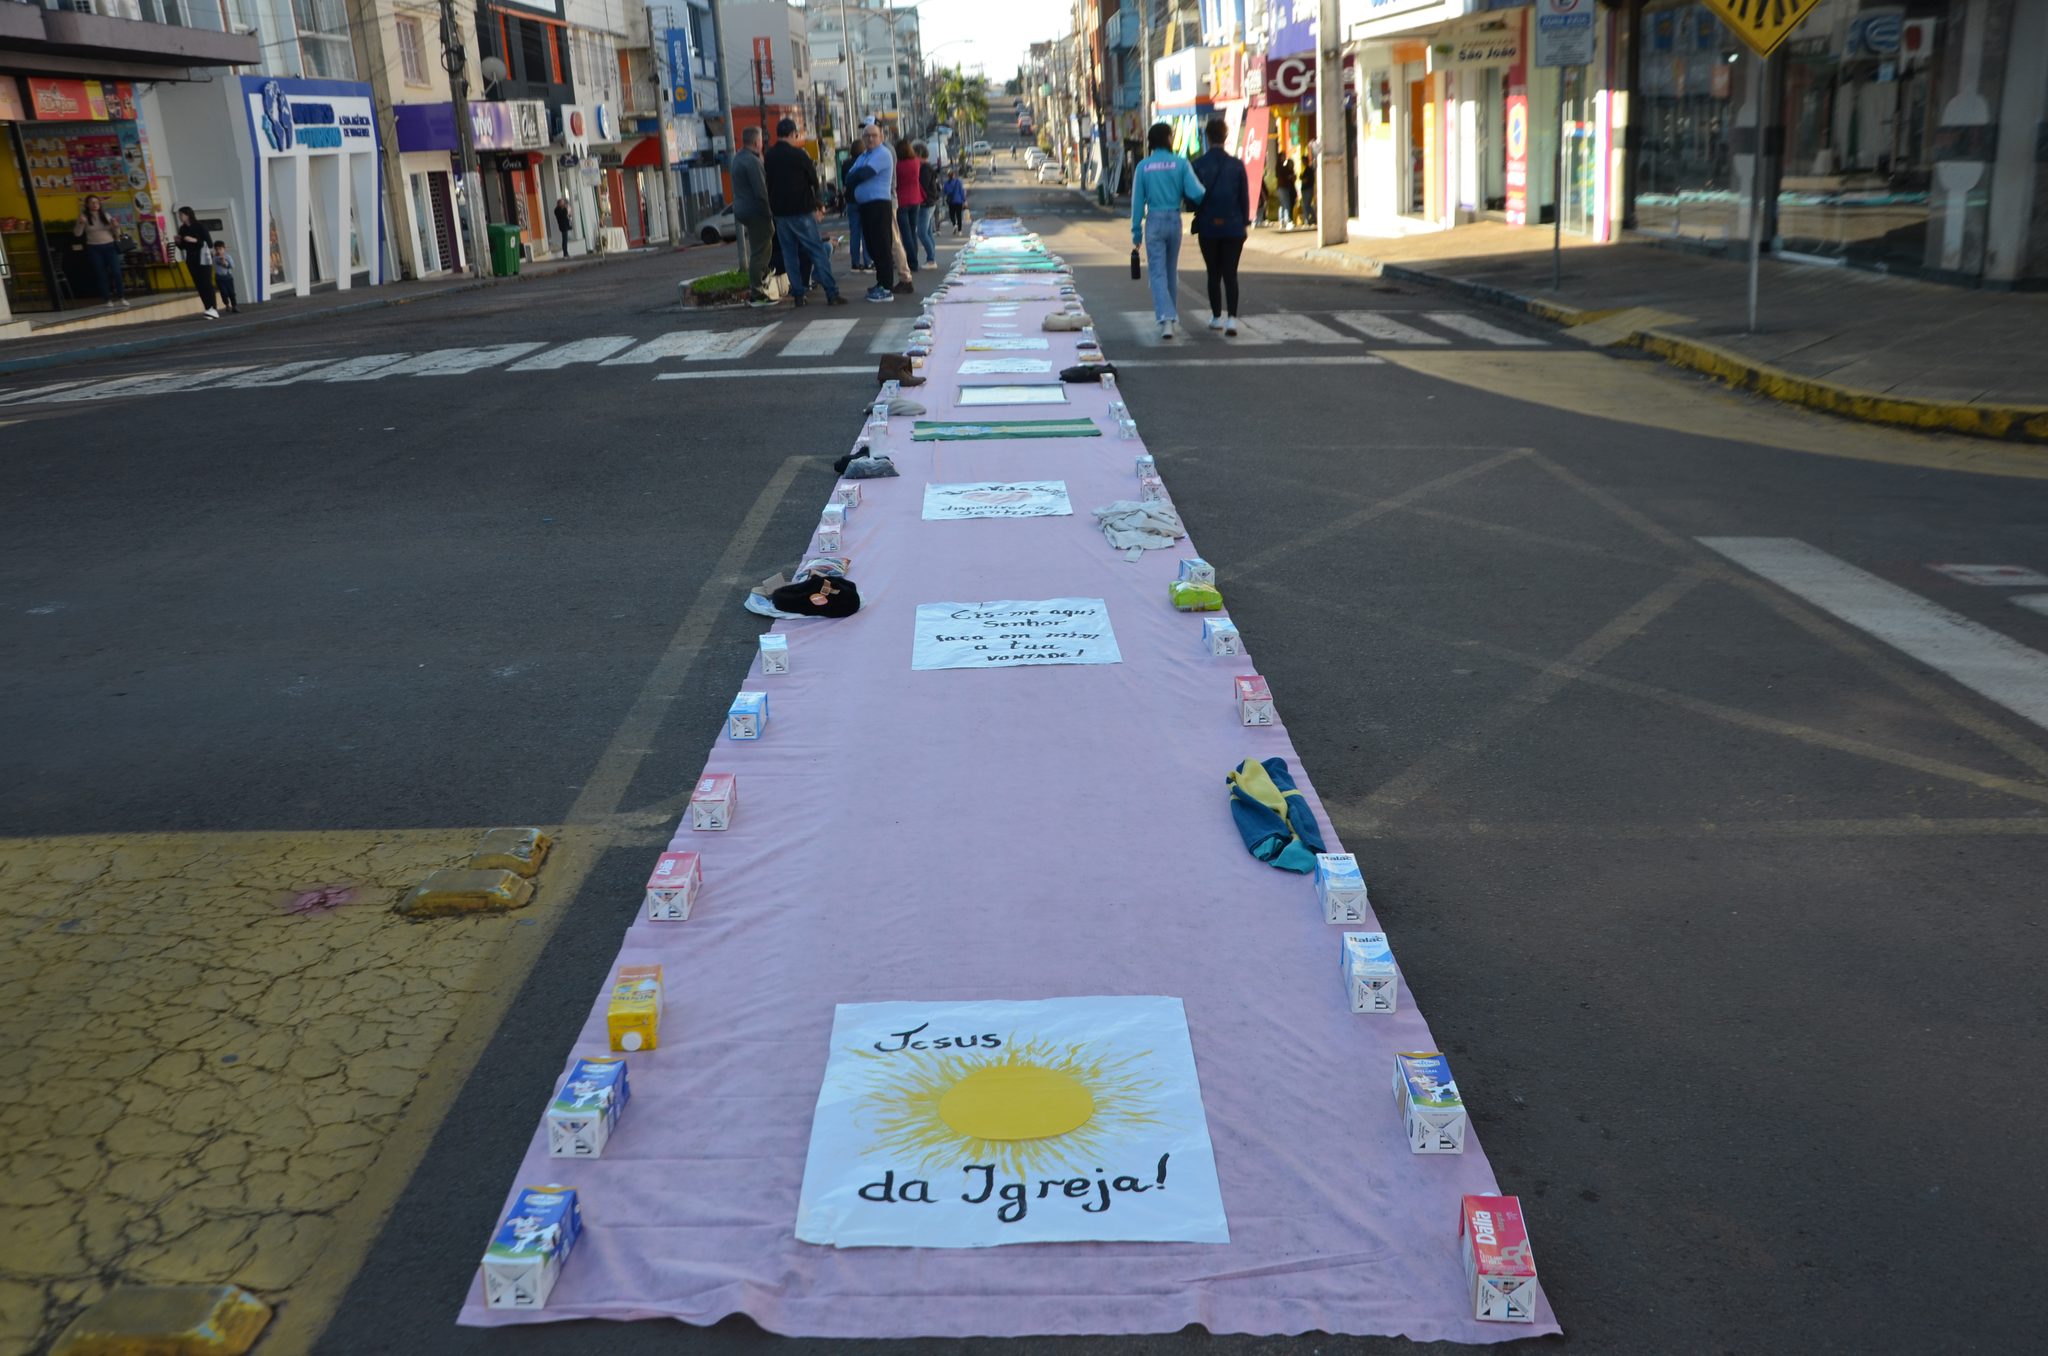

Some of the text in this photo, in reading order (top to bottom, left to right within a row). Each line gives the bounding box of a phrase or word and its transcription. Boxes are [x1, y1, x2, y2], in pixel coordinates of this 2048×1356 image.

[472, 113, 493, 136] vivo
[983, 618, 1067, 628] Senhor
[1010, 640, 1061, 650] tua
[873, 1022, 1002, 1053] Jesus
[857, 1152, 1171, 1223] da Igreja!
